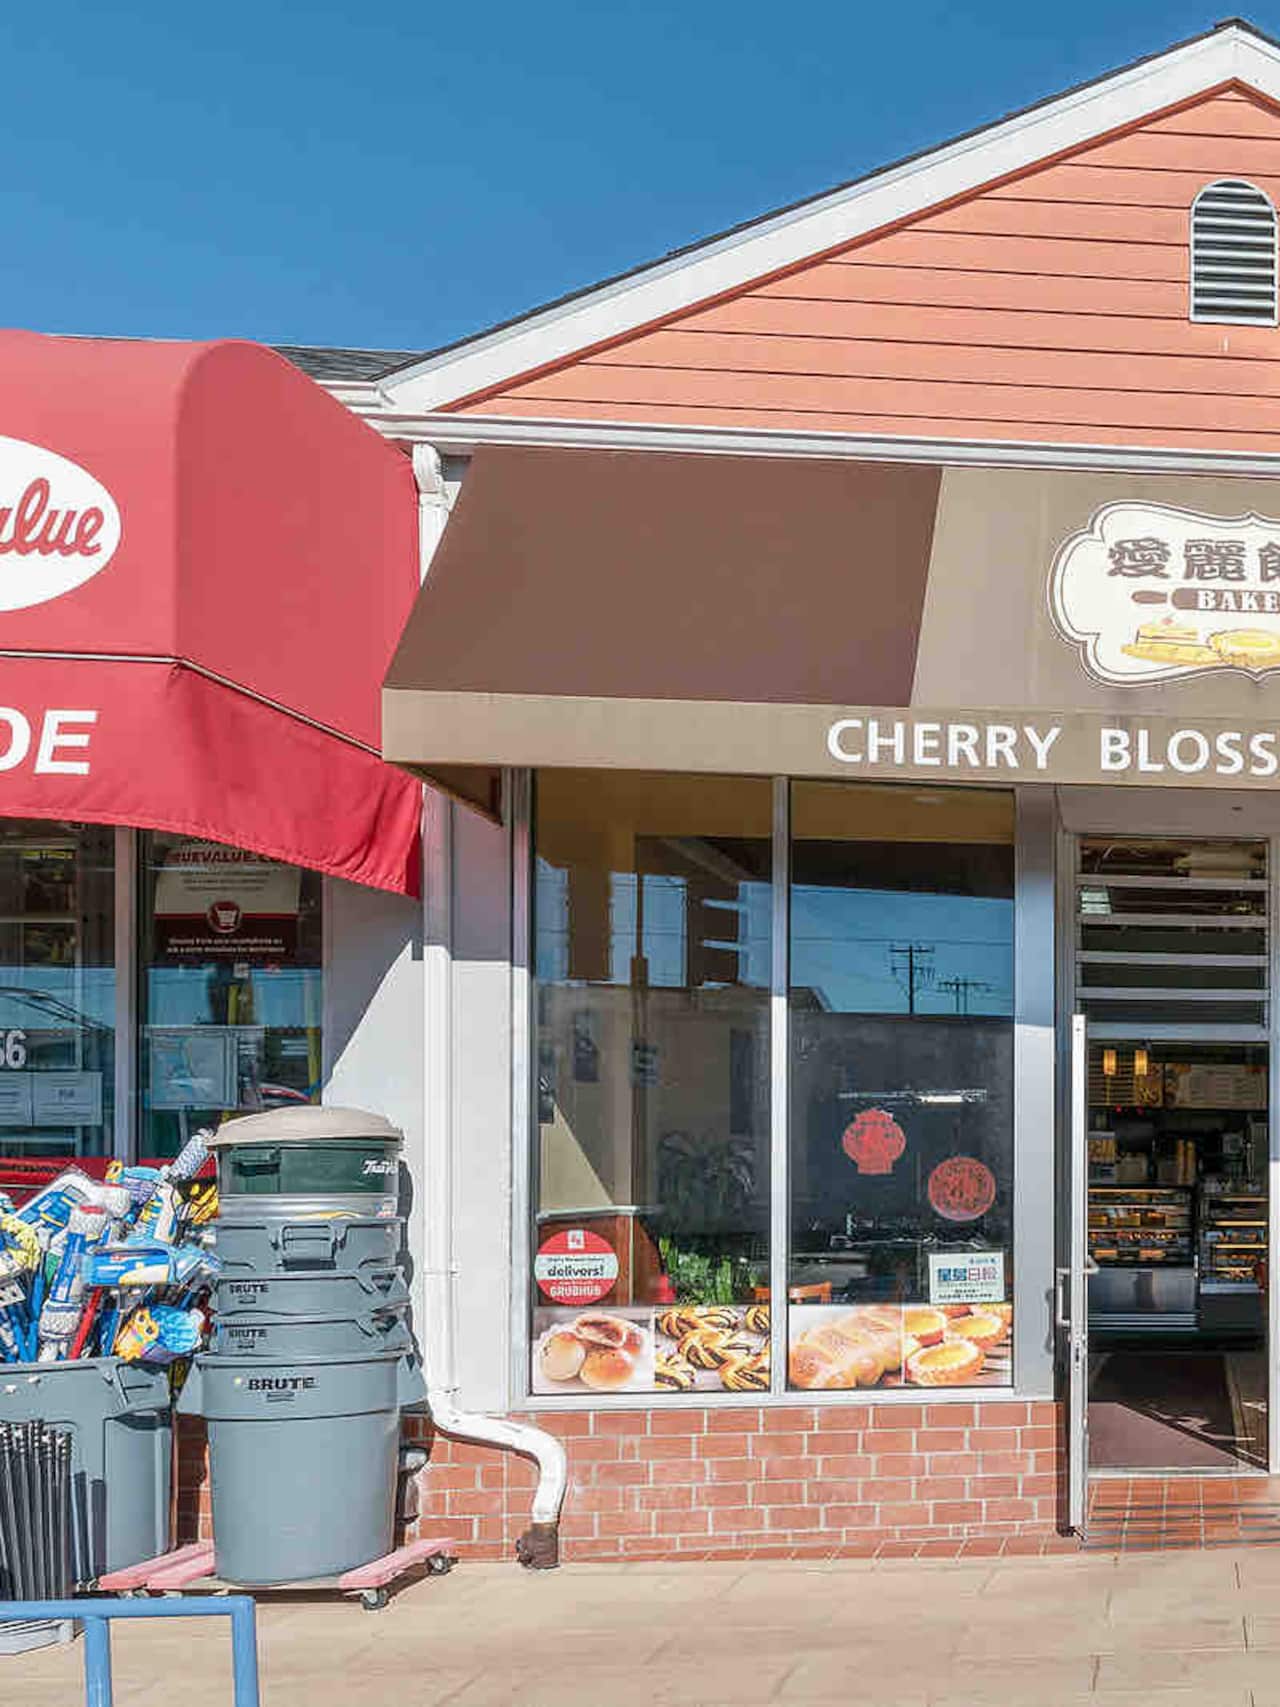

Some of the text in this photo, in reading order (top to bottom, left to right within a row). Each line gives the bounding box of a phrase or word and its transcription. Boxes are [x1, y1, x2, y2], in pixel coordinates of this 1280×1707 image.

[827, 719, 1062, 769] CHERRY
[0, 1030, 26, 1069] 6
[547, 1264, 604, 1277] delivers!
[229, 1283, 269, 1294] BRUTE
[248, 1377, 316, 1391] BRUTE
